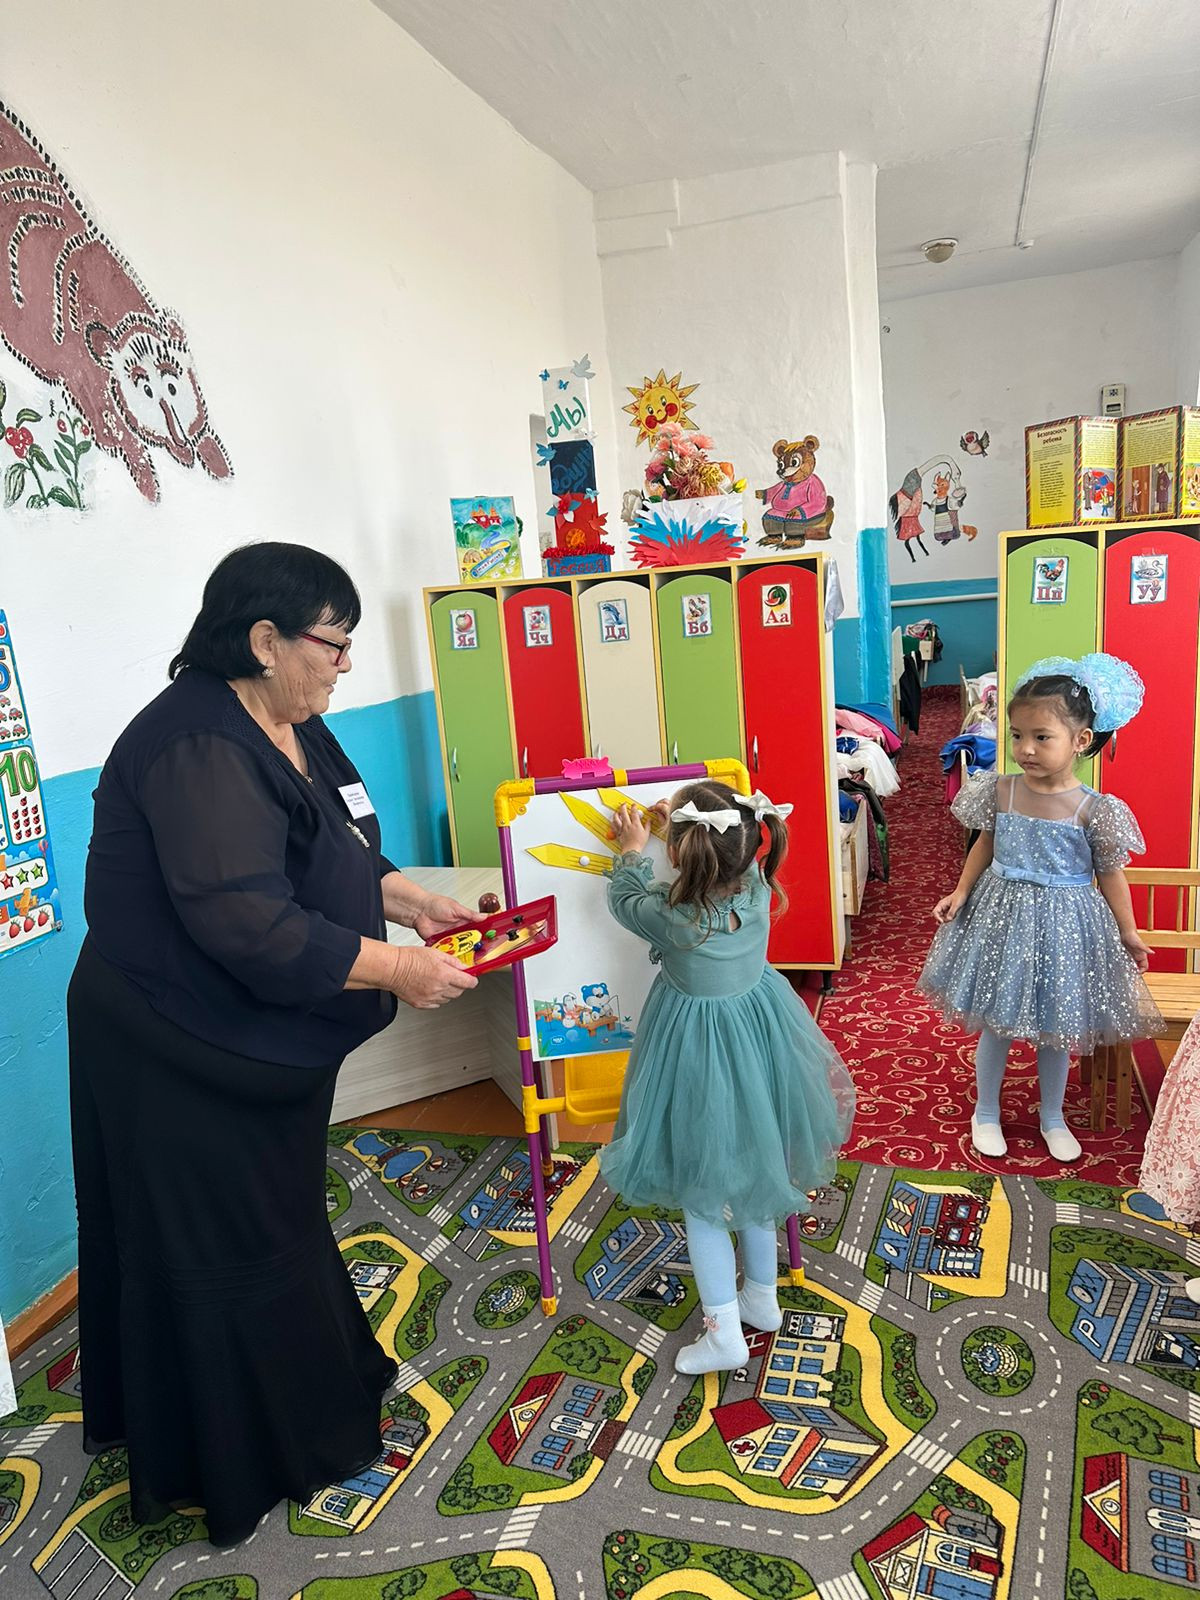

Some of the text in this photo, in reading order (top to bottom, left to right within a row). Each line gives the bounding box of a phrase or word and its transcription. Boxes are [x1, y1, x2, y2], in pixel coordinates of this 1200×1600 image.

[547, 396, 586, 438] Мы
[765, 609, 789, 624] Аа
[605, 625, 627, 640] Дд
[688, 620, 709, 634] Бб
[457, 634, 476, 647] Яя
[529, 631, 549, 644] Чч
[0, 750, 37, 797] 10
[592, 1264, 608, 1288] P
[1150, 1288, 1169, 1322] POLICE
[1078, 1318, 1102, 1348] P
